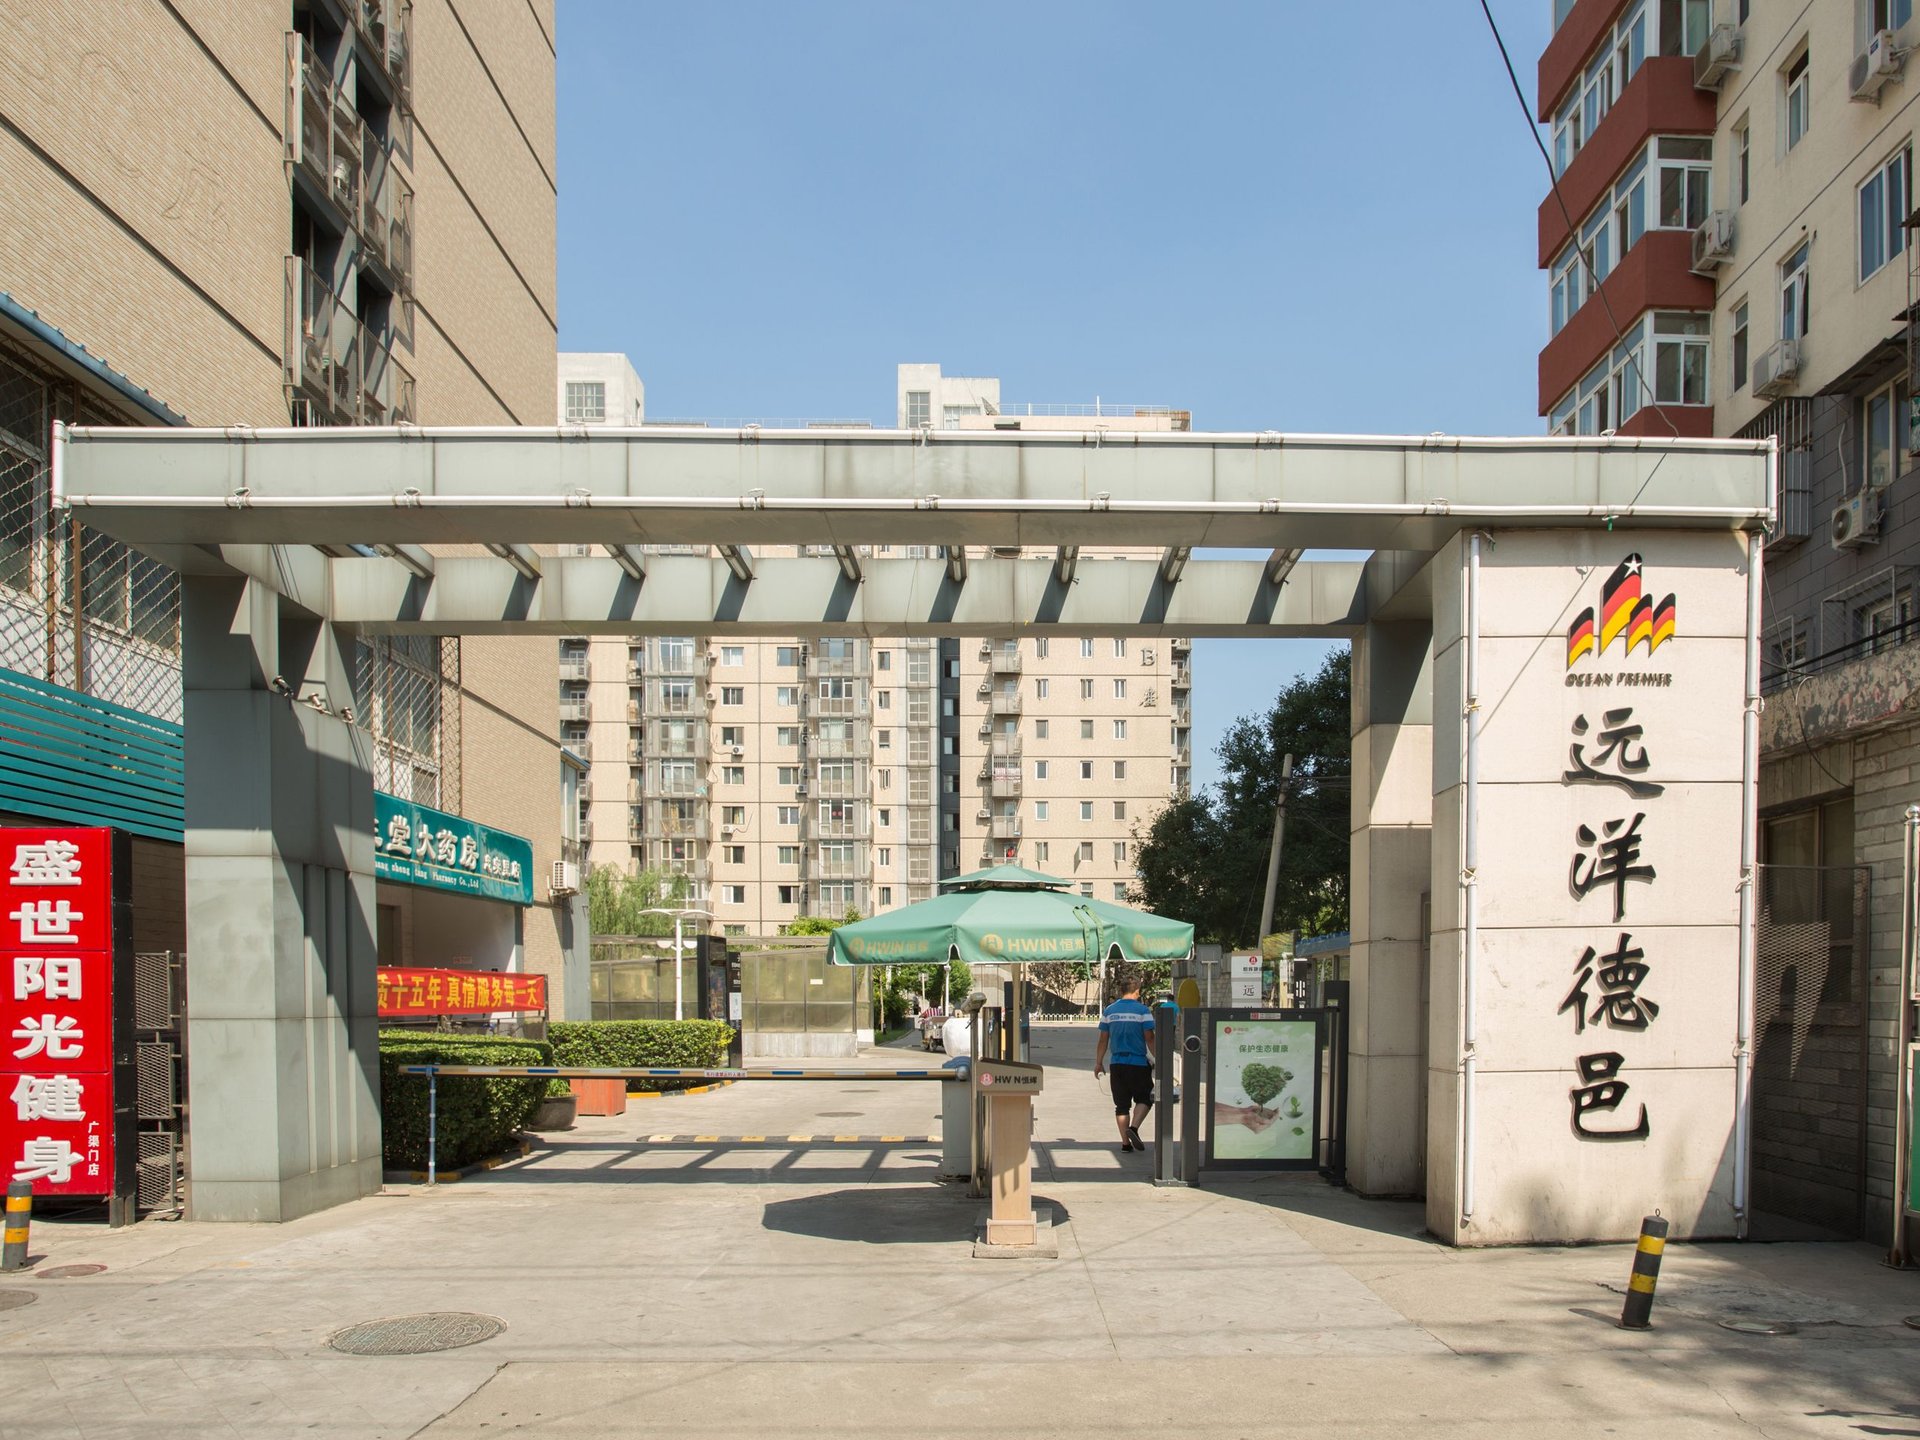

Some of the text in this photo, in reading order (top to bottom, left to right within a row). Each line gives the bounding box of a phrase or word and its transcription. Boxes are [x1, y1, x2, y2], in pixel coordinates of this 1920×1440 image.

[1564, 672, 1672, 687] OCEAN PREMIER
[1558, 707, 1666, 1142] 远洋德邑
[1007, 938, 1057, 953] HWIN
[447, 976, 538, 1009] 真情服务每一天
[9, 839, 87, 1184] 盛世阳光健身
[1239, 1044, 1289, 1053] 保护生态健康
[87, 1121, 100, 1176] 广渠门店
